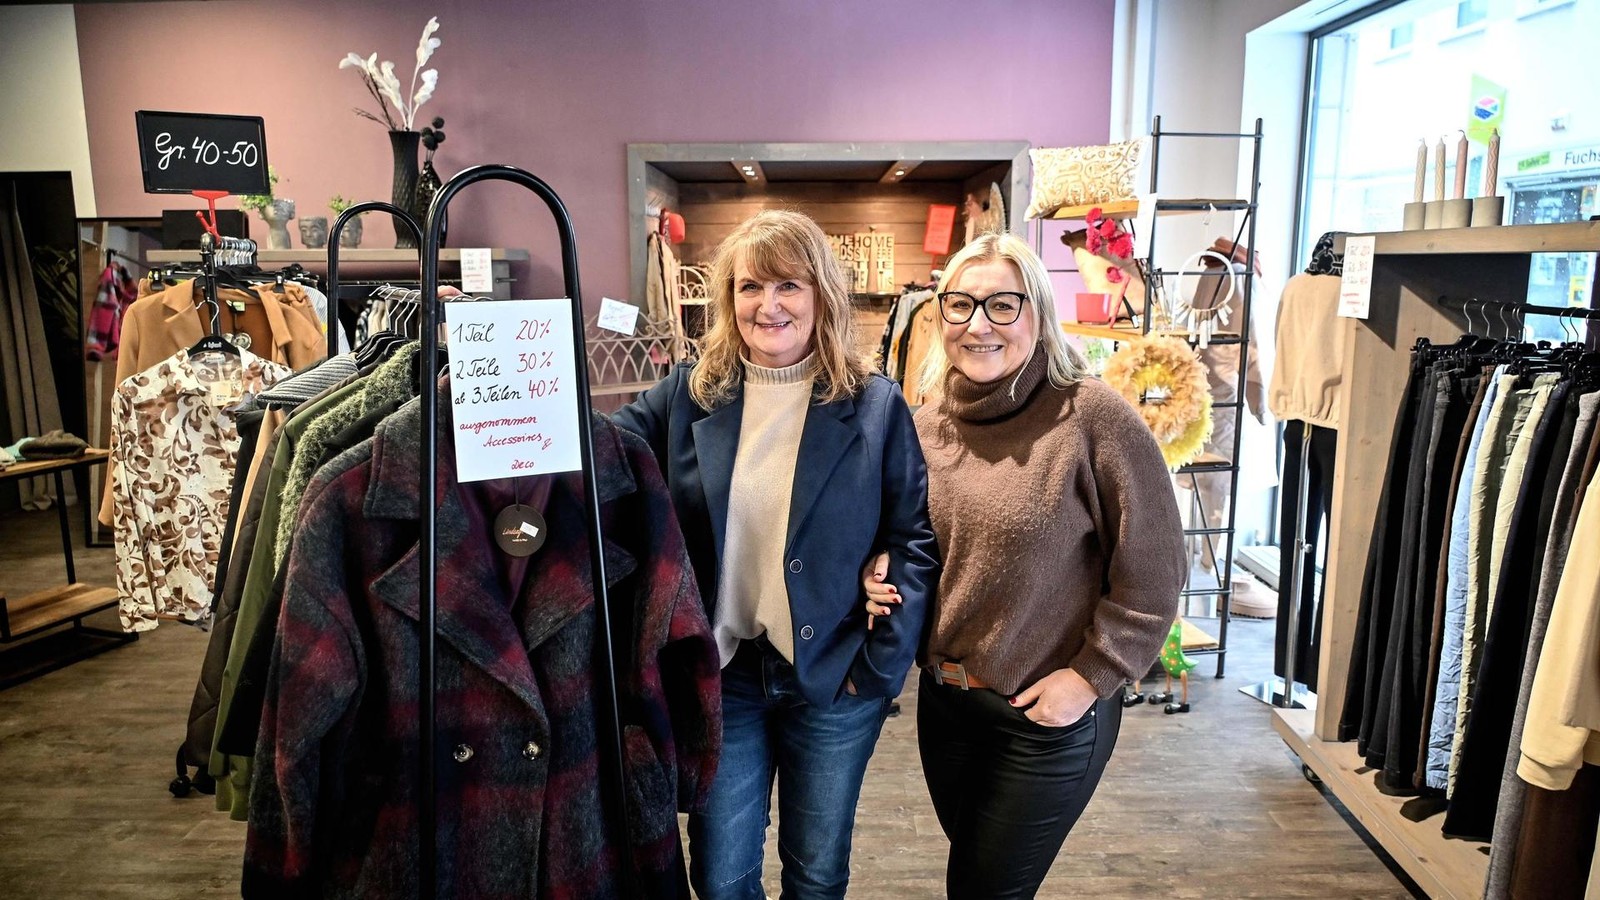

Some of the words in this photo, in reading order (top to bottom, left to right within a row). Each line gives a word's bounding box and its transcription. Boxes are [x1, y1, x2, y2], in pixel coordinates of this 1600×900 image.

[155, 132, 186, 170] Gr.
[192, 136, 258, 167] 40-50
[452, 323, 463, 343] 1
[465, 322, 495, 342] Teil
[515, 319, 552, 341] 20%
[456, 360, 464, 380] 2
[466, 357, 501, 378] Teile
[454, 393, 466, 405] ab
[471, 386, 482, 404] 3
[483, 384, 522, 403] Teilen
[459, 415, 538, 434] ausgenommen
[483, 433, 543, 448] Accessoires
[511, 459, 535, 470] Deco
